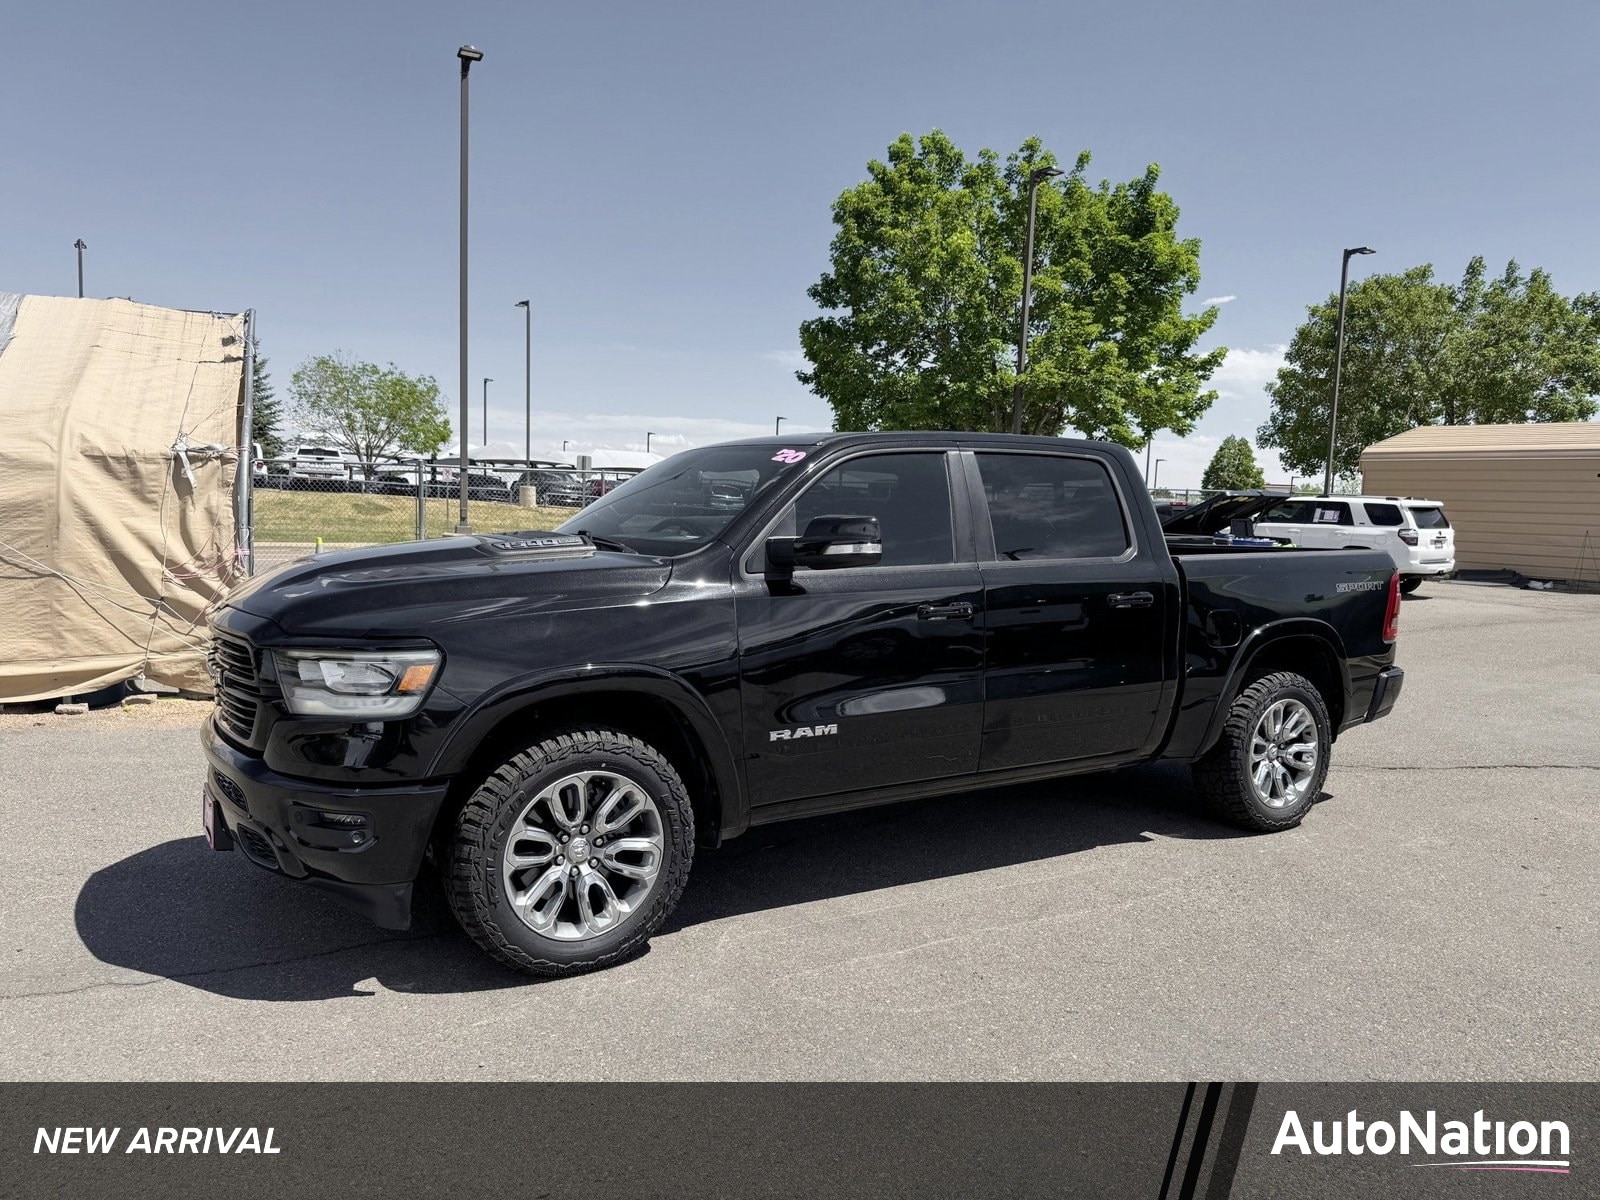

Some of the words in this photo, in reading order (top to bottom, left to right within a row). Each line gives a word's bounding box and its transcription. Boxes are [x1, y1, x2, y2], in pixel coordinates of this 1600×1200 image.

[771, 448, 807, 464] 20
[1336, 580, 1384, 593] SPORT
[769, 723, 838, 742] RAM
